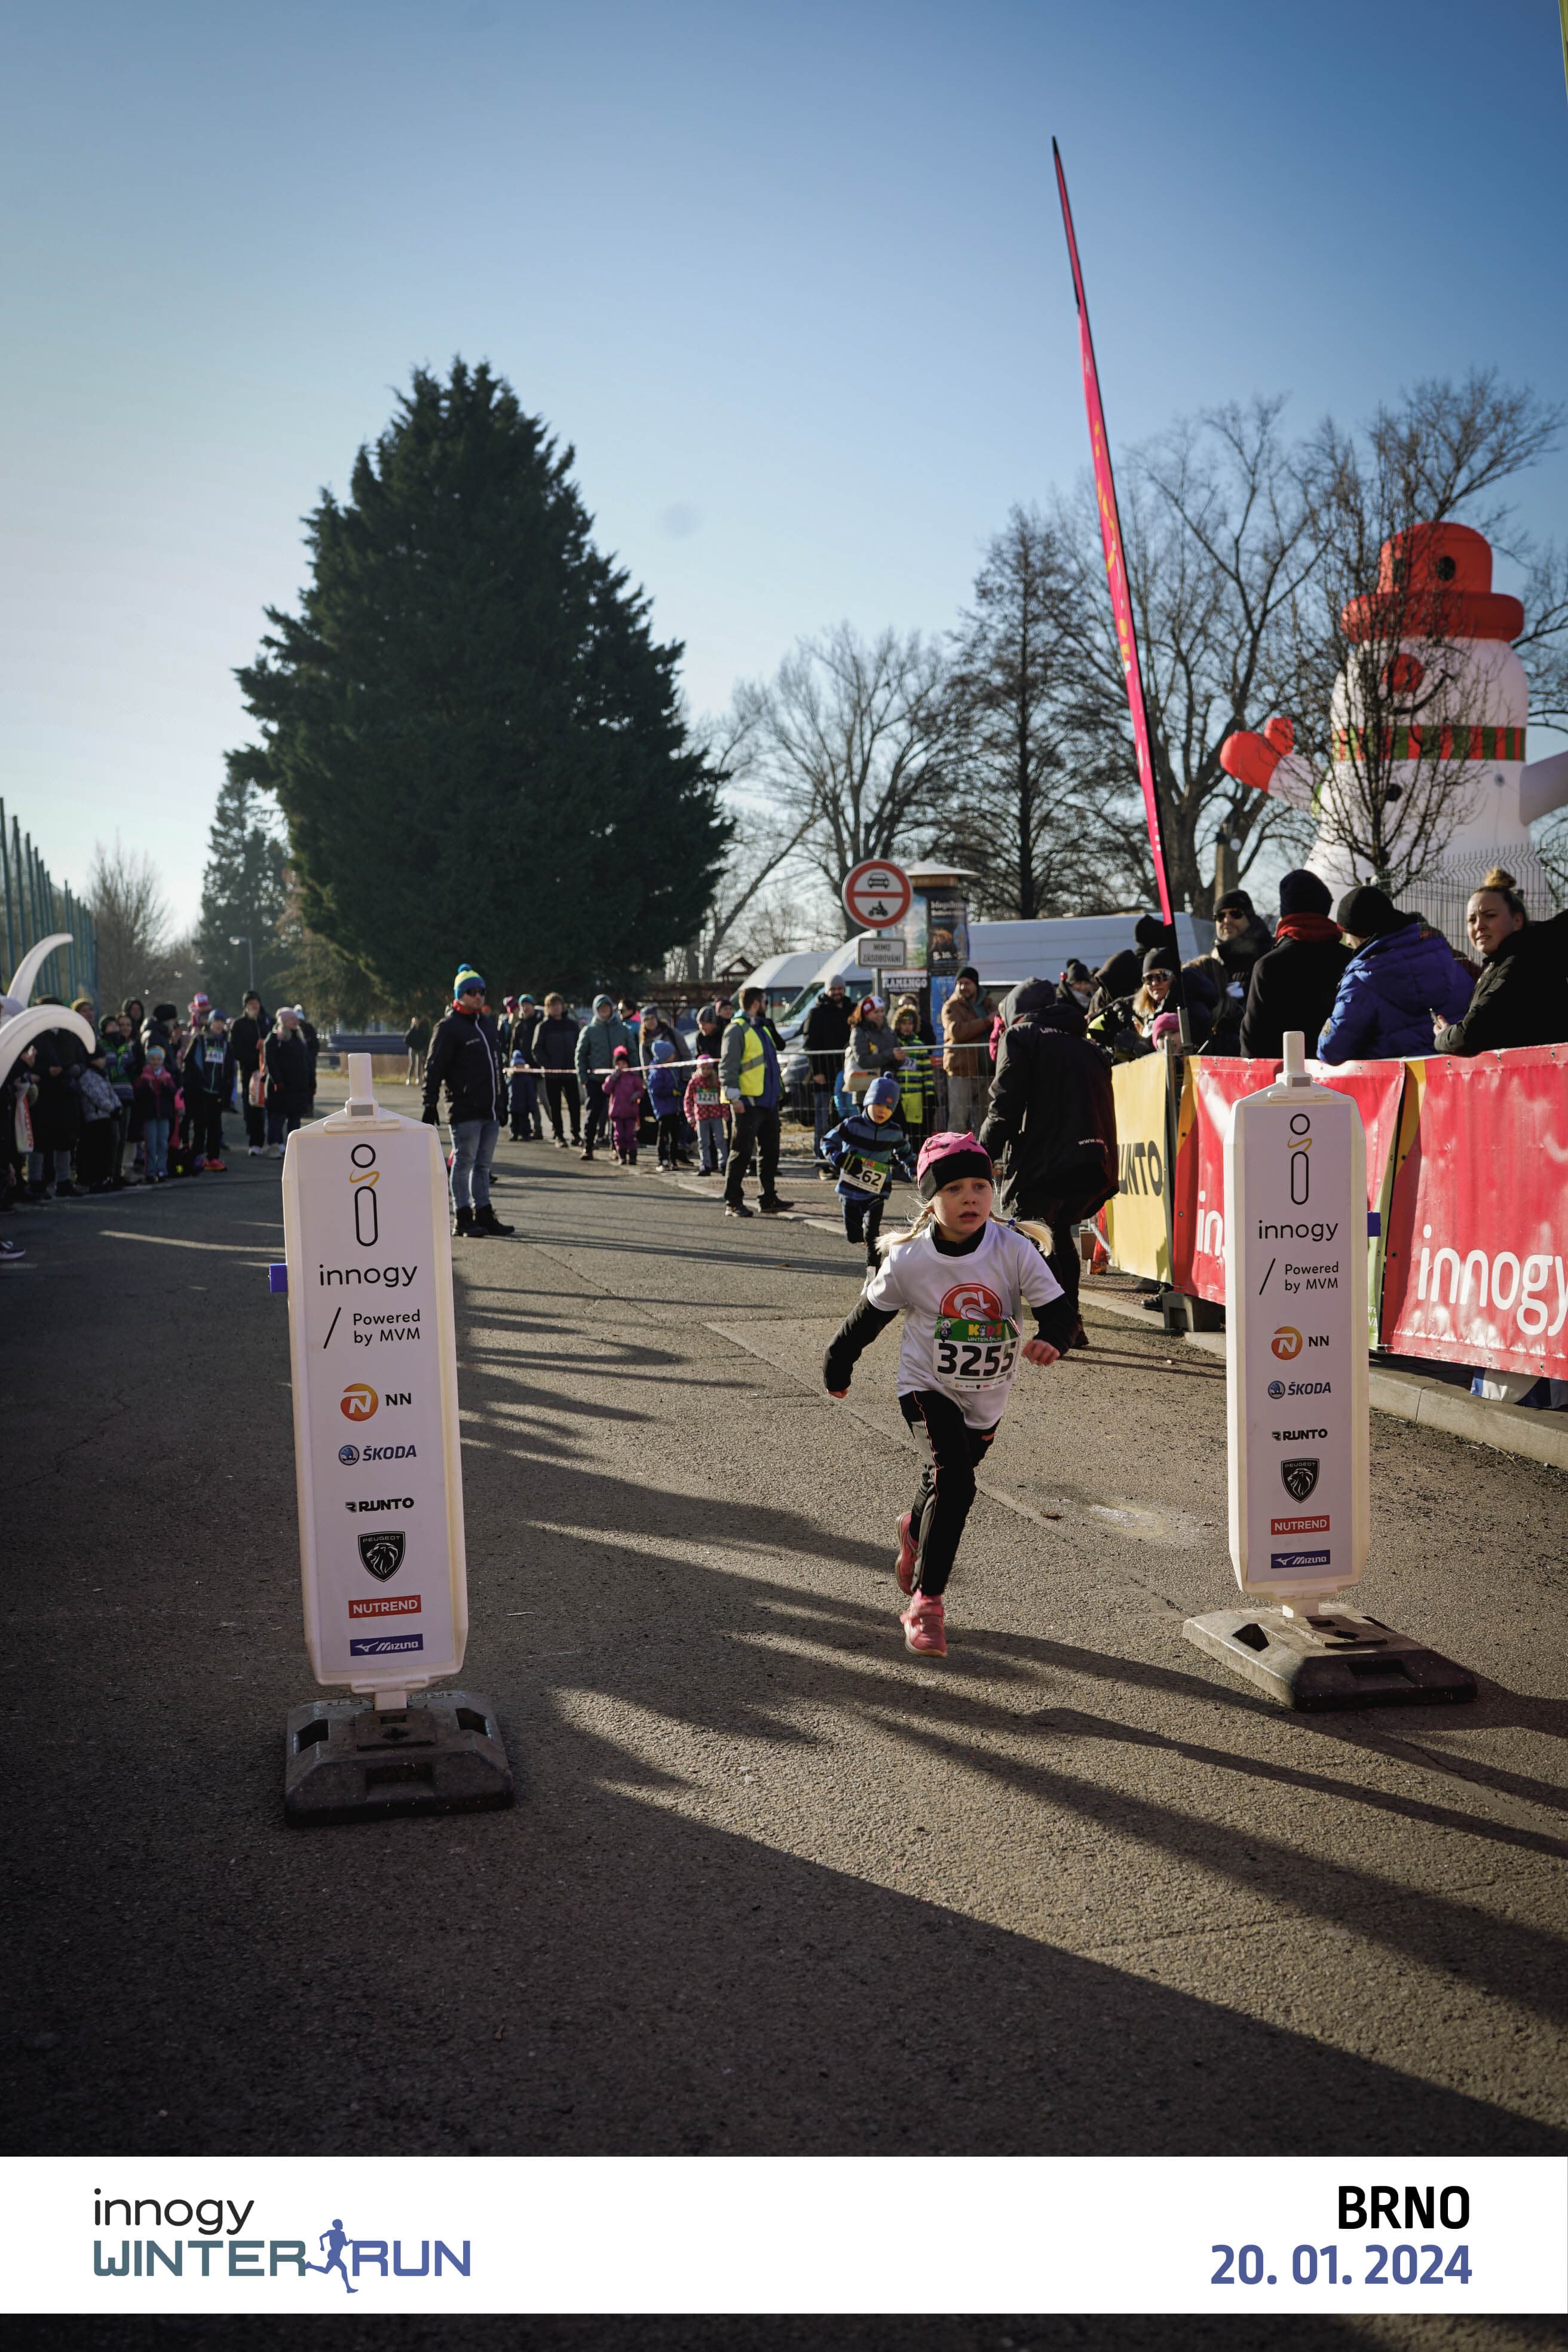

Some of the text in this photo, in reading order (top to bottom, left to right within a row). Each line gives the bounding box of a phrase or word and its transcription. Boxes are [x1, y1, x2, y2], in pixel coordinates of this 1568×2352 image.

[1117, 1140, 1163, 1196] UNTO
[1258, 1220, 1339, 1242] innogy
[319, 1264, 418, 1288] innogy
[1285, 1261, 1339, 1275] Powered
[1285, 1277, 1338, 1294] by MVM
[1417, 1224, 1568, 1337] innogy
[353, 1309, 420, 1326] Powered
[354, 1327, 420, 1347] by MVM
[1308, 1335, 1330, 1347] NN
[937, 1341, 1016, 1377] 3255
[1287, 1381, 1331, 1396] ŠKODA
[385, 1392, 412, 1406] NN
[1283, 1428, 1328, 1441] RUNTO
[362, 1444, 417, 1462] ŠKODA
[359, 1497, 415, 1512] RUNTO
[1274, 1519, 1327, 1532] NUTREND
[362, 1535, 401, 1543] PEUGEOT
[353, 1598, 418, 1615] NUTREND
